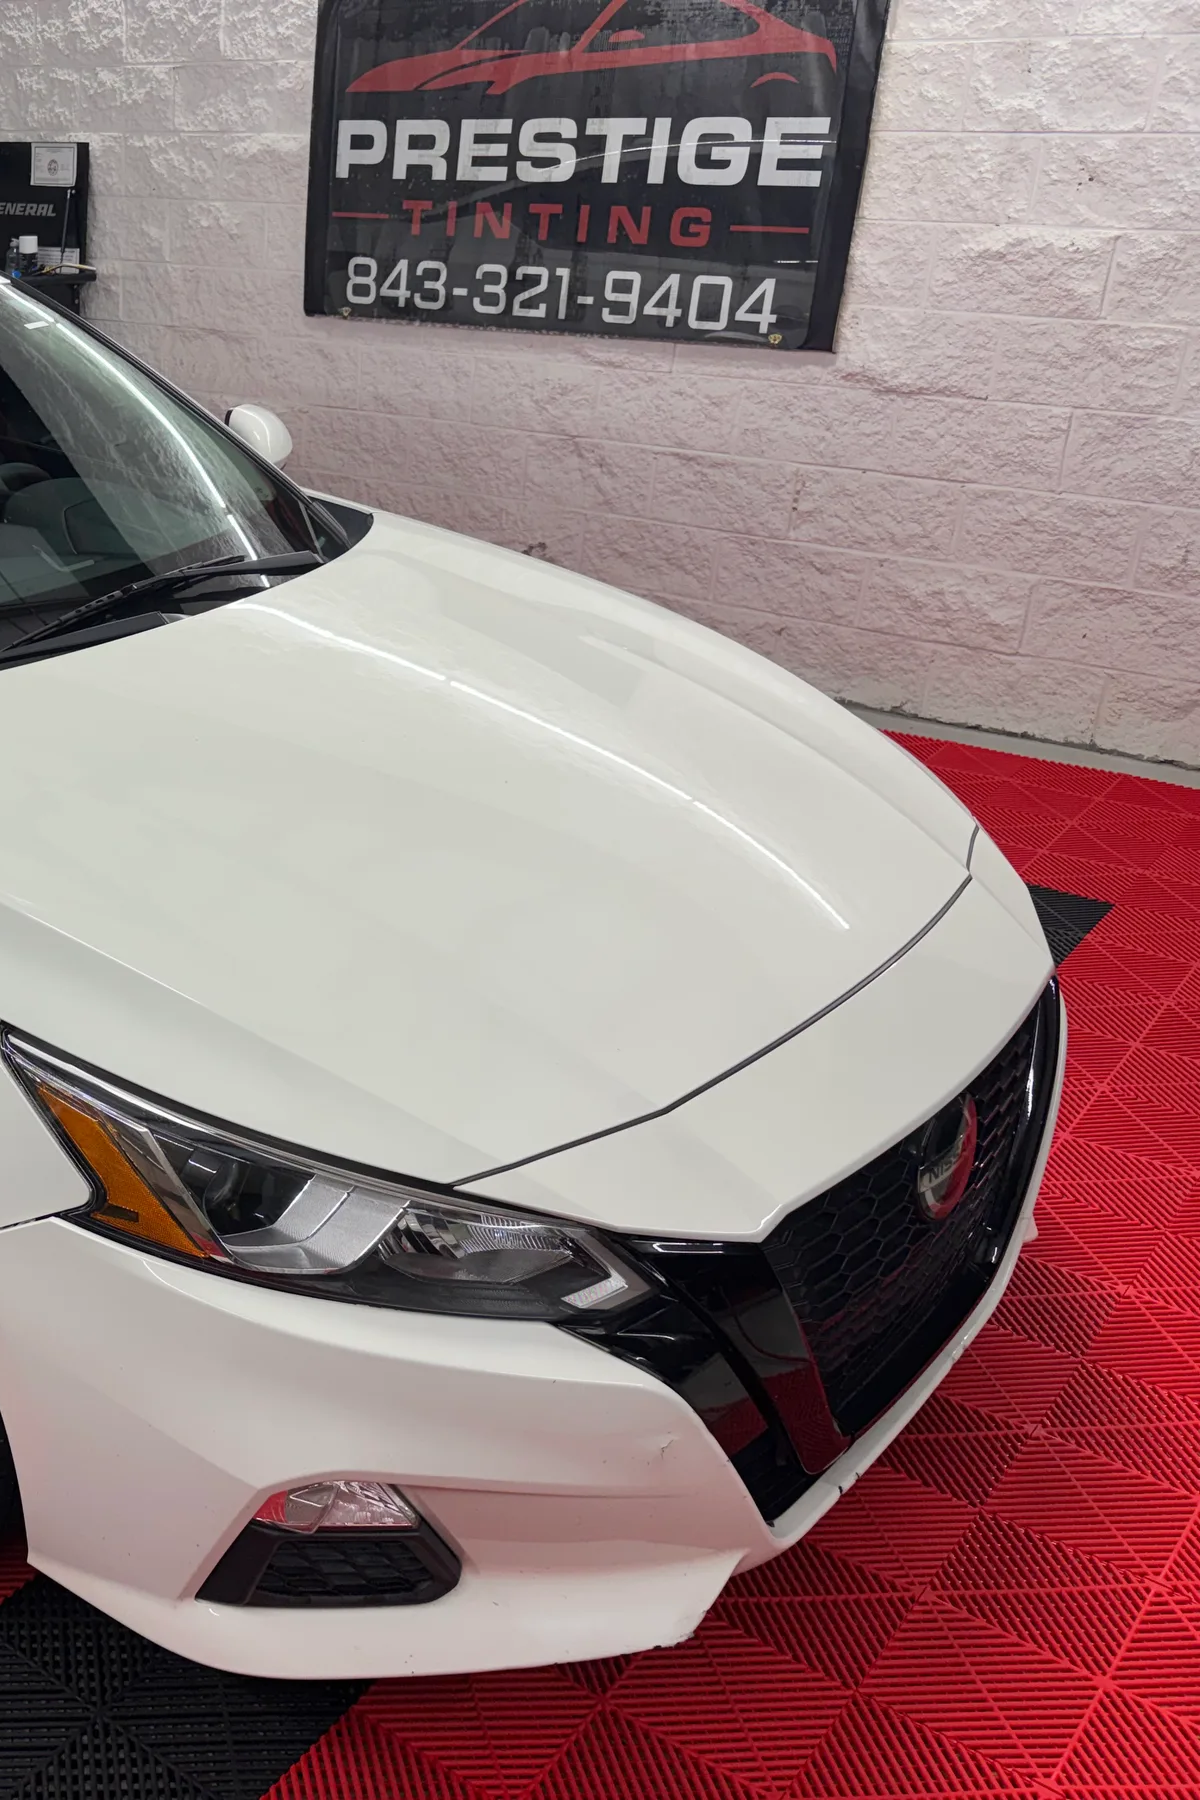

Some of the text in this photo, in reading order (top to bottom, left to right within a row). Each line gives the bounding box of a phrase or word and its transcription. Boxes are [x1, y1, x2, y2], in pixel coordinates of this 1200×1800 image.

[336, 116, 832, 188] PRESTIGE
[402, 199, 712, 248] TINTING
[346, 256, 778, 334] 843-321-9404
